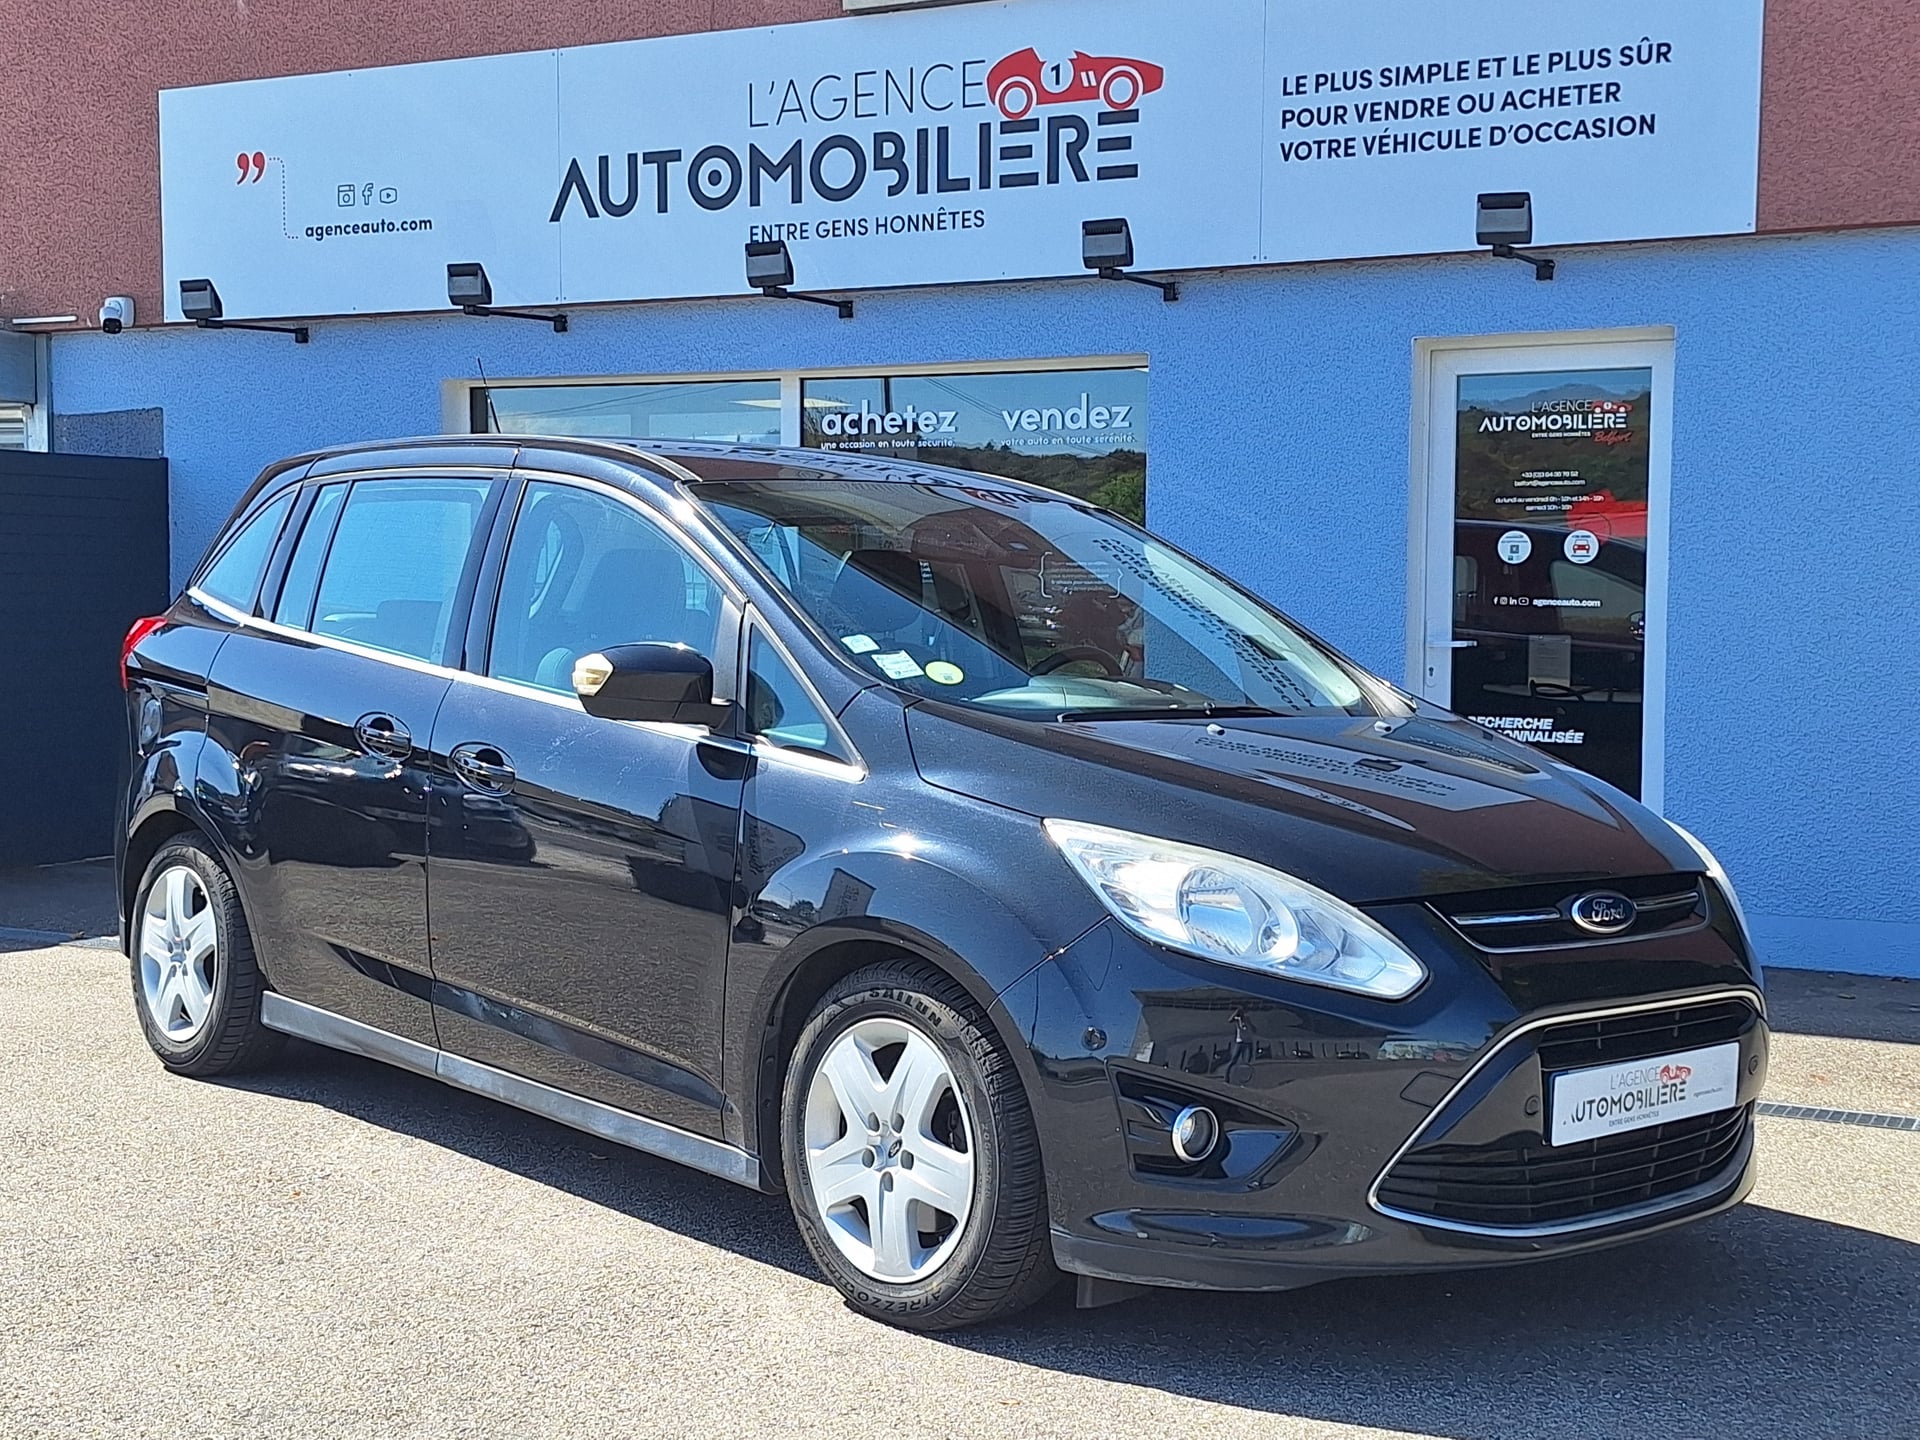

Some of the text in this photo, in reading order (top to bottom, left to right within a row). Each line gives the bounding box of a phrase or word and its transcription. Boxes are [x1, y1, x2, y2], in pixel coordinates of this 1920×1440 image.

[1051, 63, 1062, 87] 1
[1281, 36, 1673, 97] LE PLUS SIMPLE ET LE PLUS SÛR
[1281, 81, 1622, 130] POUR VENDRE OU ACHETER
[1279, 113, 1656, 162] VOTRE VÉHICULE D'OCCASION
[304, 218, 433, 241] agenceauto.com
[749, 206, 986, 243] ENTRE GENS HONNÊTES
[821, 399, 959, 437] achetez
[999, 392, 1132, 433] vendez
[820, 441, 837, 450] une
[839, 438, 876, 449] occasion
[878, 439, 889, 448] en
[891, 438, 915, 448] toute
[1001, 437, 1025, 447] votre
[1027, 437, 1049, 446] auto
[1051, 437, 1063, 445] en
[1066, 435, 1092, 444] toute
[1591, 898, 1626, 922] Ford
[869, 986, 943, 1028] SAILUN
[856, 1286, 943, 1314] ATREZZO
